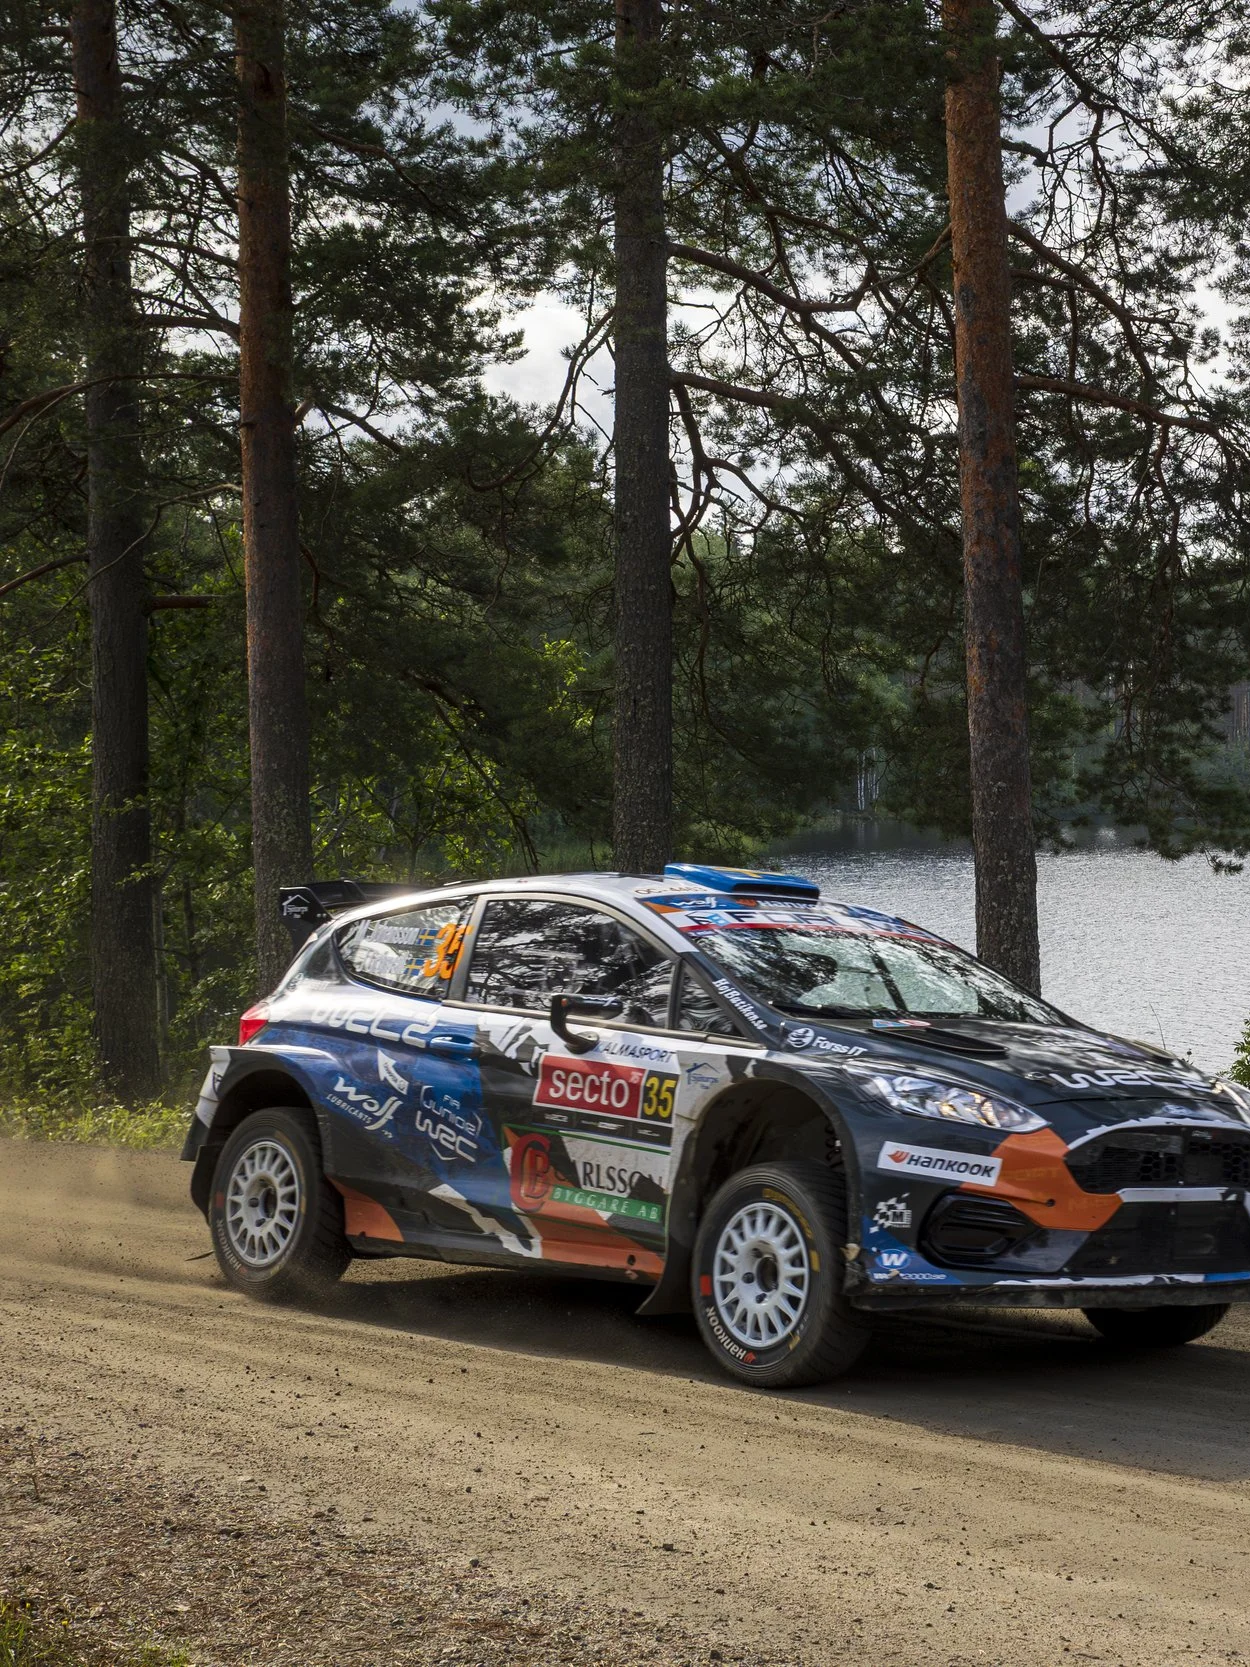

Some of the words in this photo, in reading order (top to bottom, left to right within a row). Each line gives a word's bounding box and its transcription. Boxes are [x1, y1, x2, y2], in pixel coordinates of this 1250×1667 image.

[549, 1069, 630, 1108] secto
[642, 1076, 677, 1118] 35
[326, 1093, 373, 1125] LUBRICANTS
[552, 1186, 629, 1214] BYGGARE
[638, 1205, 658, 1219] AB
